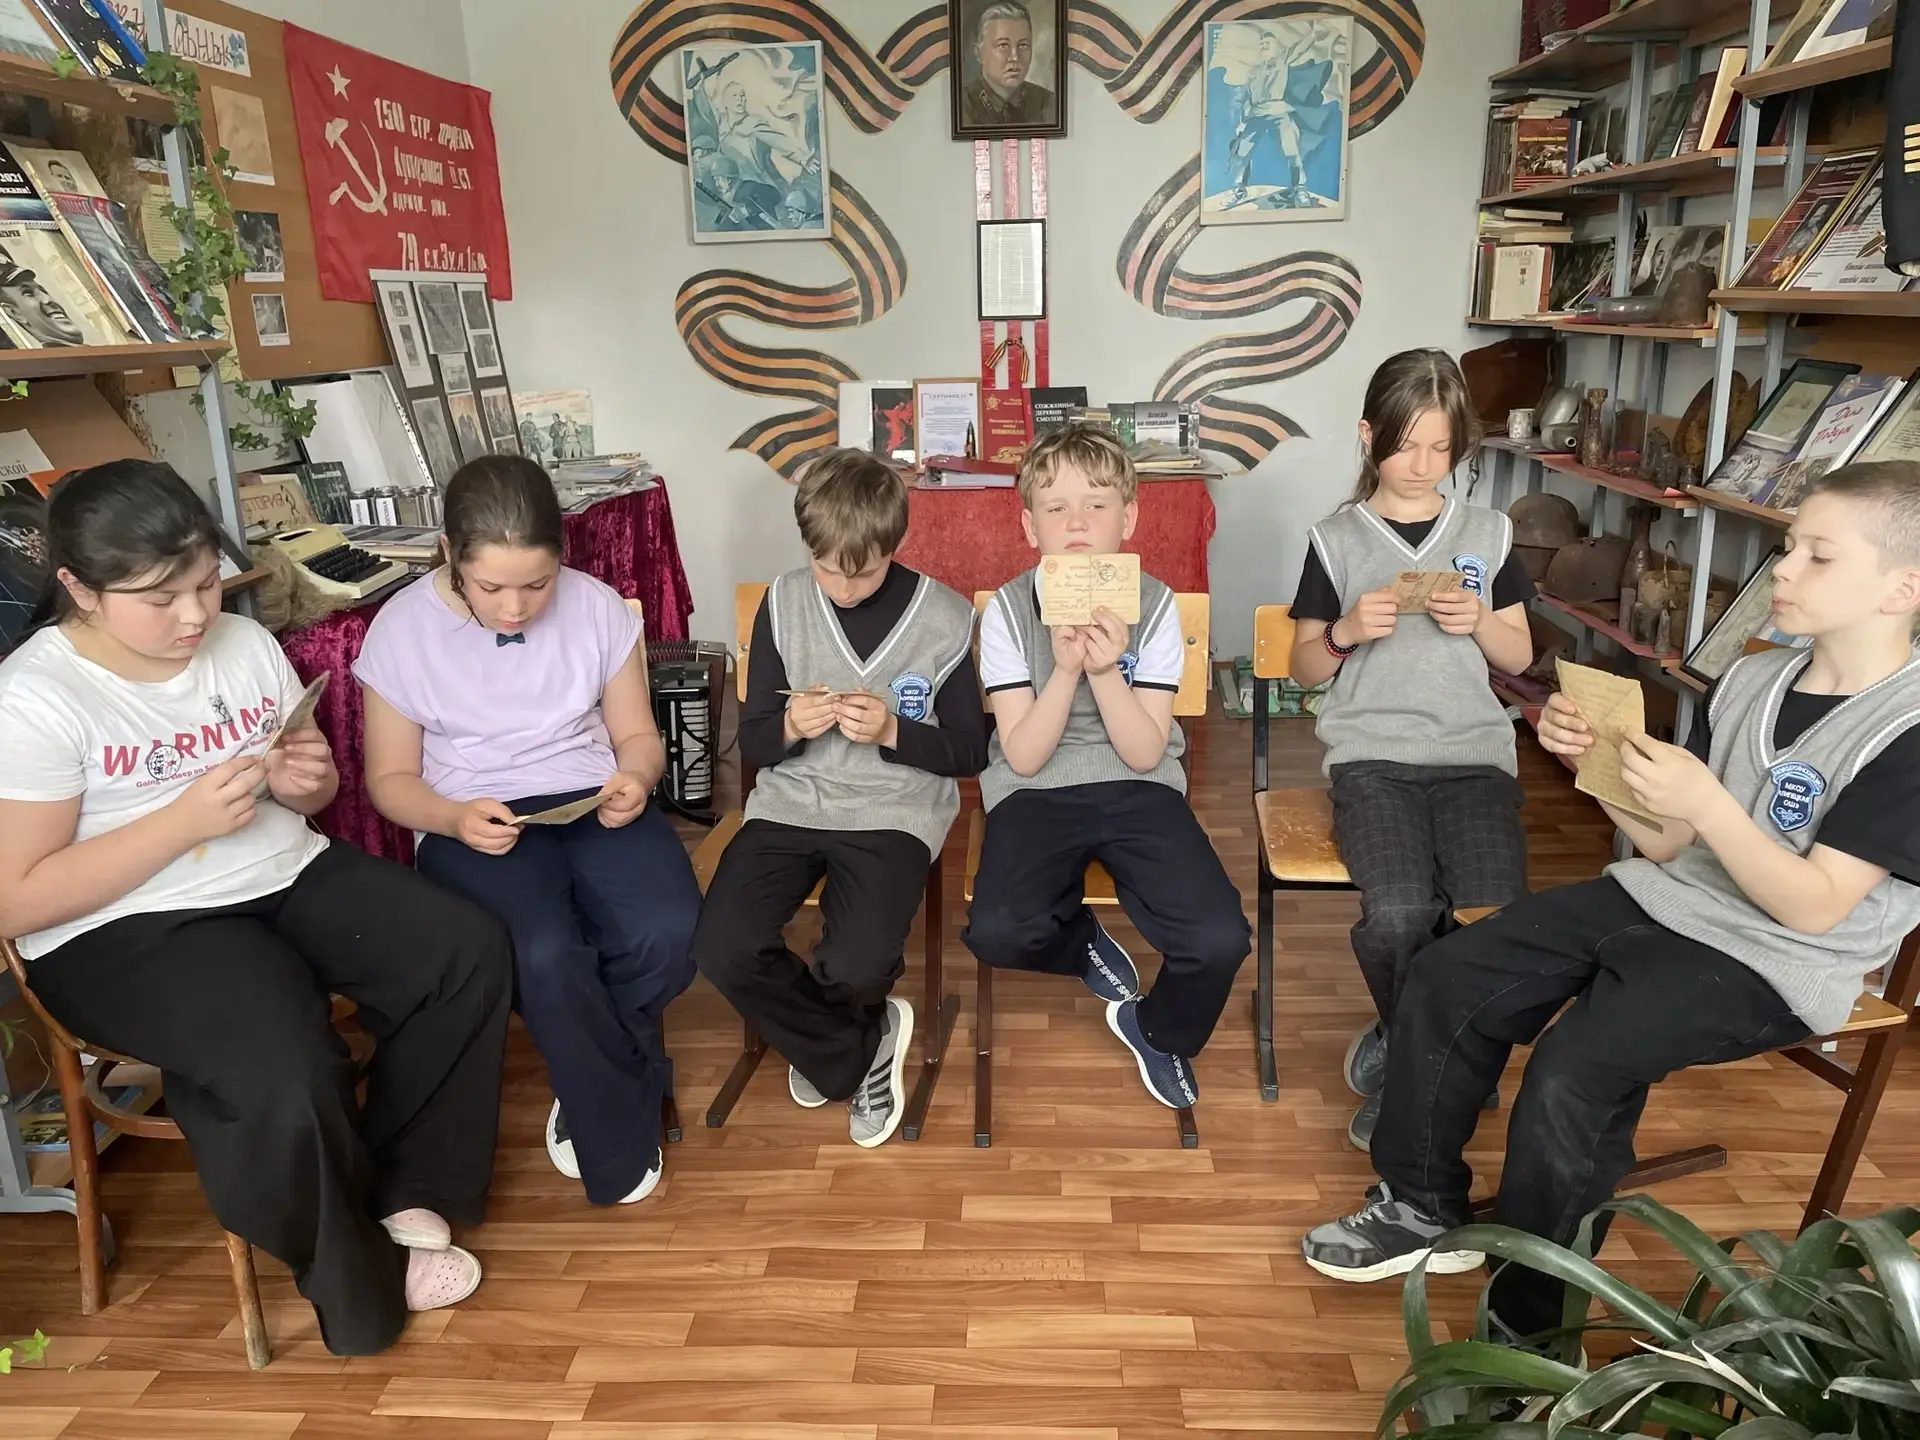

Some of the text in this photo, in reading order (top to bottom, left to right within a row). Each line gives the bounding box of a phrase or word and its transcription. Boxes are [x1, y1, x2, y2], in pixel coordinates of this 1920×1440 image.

[374, 98, 405, 133] 150
[397, 231, 420, 271] 79
[136, 778, 161, 788] Going
[193, 768, 204, 777] on
[1784, 782, 1807, 793] МКОУ
[1179, 1078, 1197, 1105] SPORT
